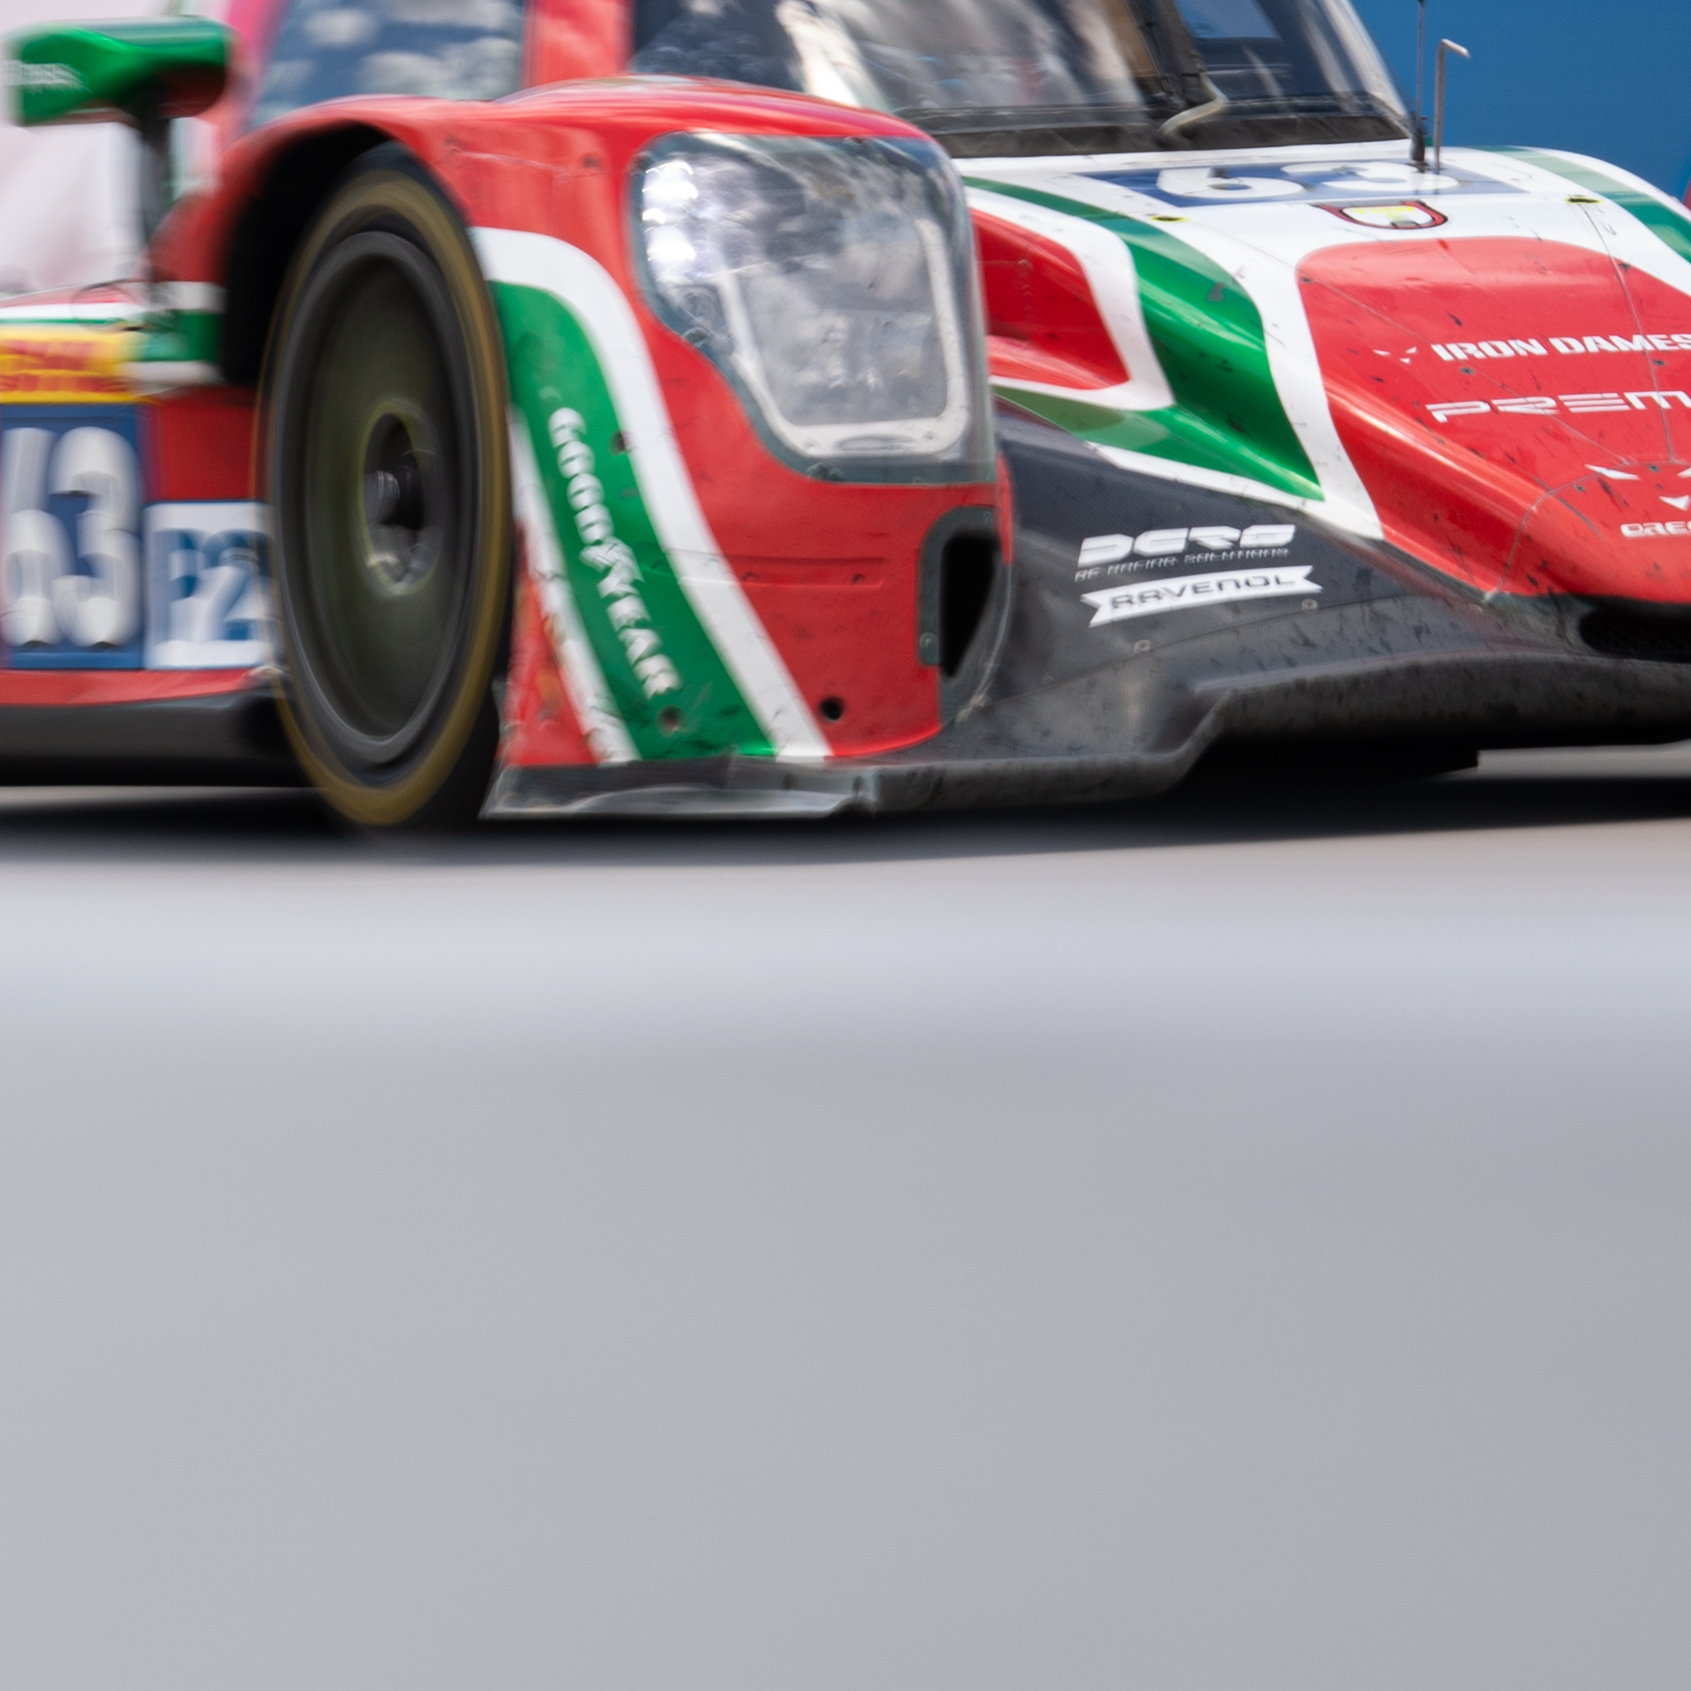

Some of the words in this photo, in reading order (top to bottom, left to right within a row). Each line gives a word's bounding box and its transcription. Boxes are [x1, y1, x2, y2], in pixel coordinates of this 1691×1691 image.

[1156, 161, 1362, 199] 63
[1431, 338, 1550, 362] IRON
[547, 406, 684, 701] GOODYEAR
[153, 528, 276, 643] P2
[1109, 574, 1296, 610] RAVENOL
